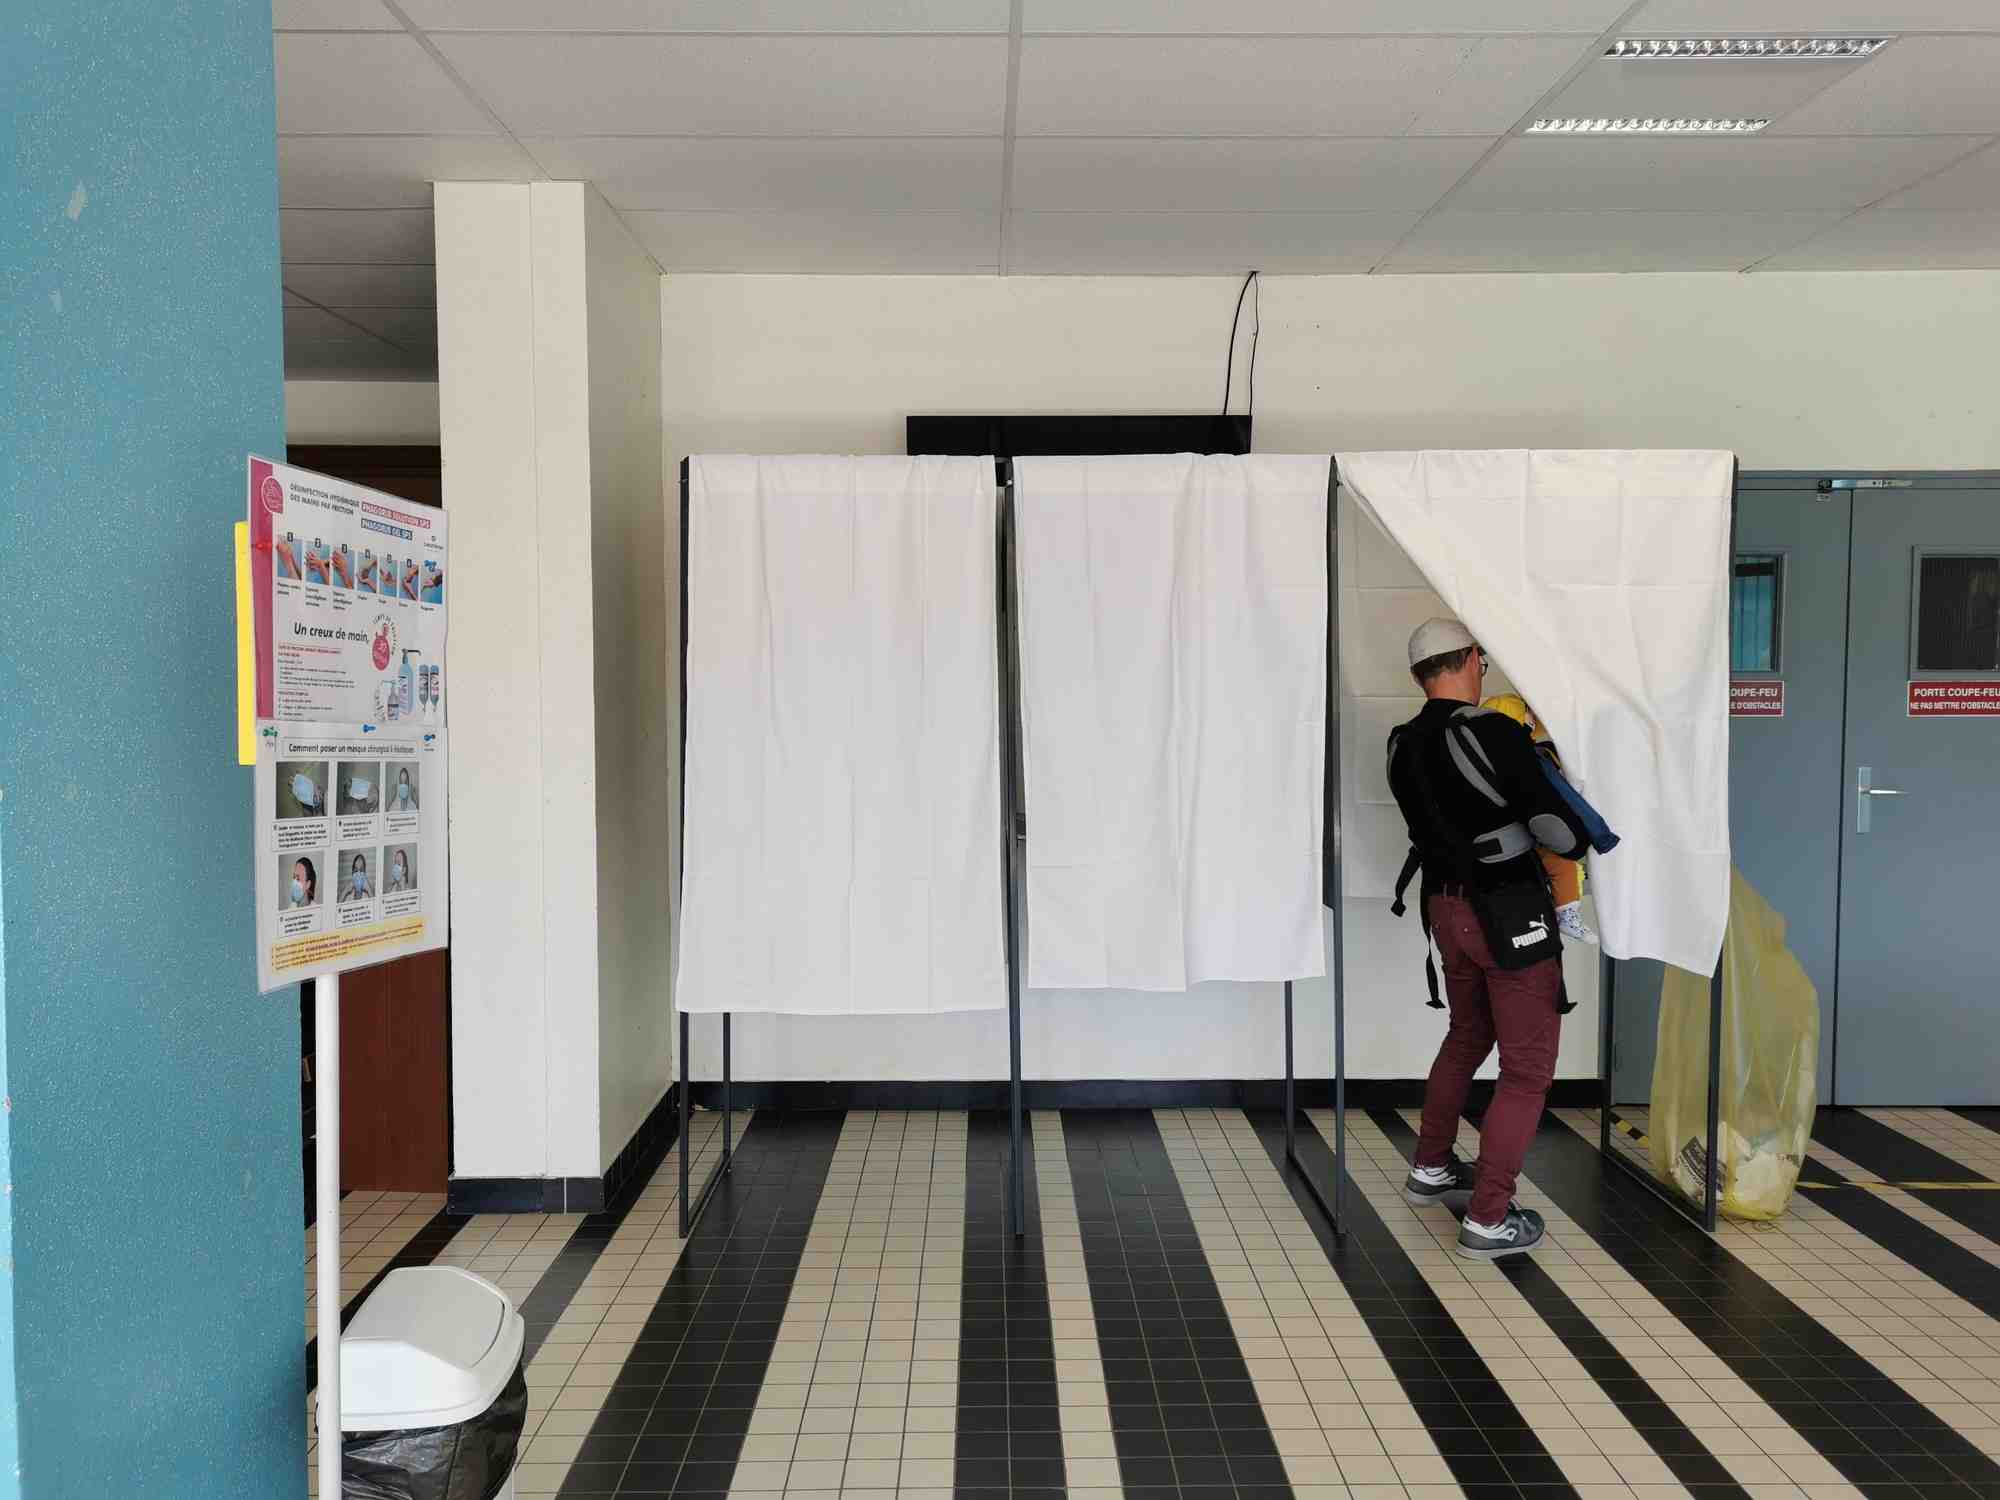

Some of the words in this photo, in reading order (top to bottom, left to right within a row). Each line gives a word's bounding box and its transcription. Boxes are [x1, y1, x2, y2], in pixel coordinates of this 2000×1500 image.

[294, 621, 307, 636] Un
[309, 626, 334, 639] creux
[335, 627, 346, 640] de
[1730, 687, 1778, 697] OUPE-FEU
[1914, 687, 1945, 697] PORTE
[1947, 687, 2000, 697] COUPE-FEU
[1910, 701, 1920, 710] NE
[1920, 701, 1933, 710] PAS
[1934, 701, 1960, 710] METTRE
[1961, 701, 2000, 710] D'OBSTACLE
[289, 743, 319, 753] Comment
[320, 744, 338, 755] poser
[338, 745, 346, 753] un
[346, 744, 366, 755] masque
[1511, 927, 1548, 949] PUMA
